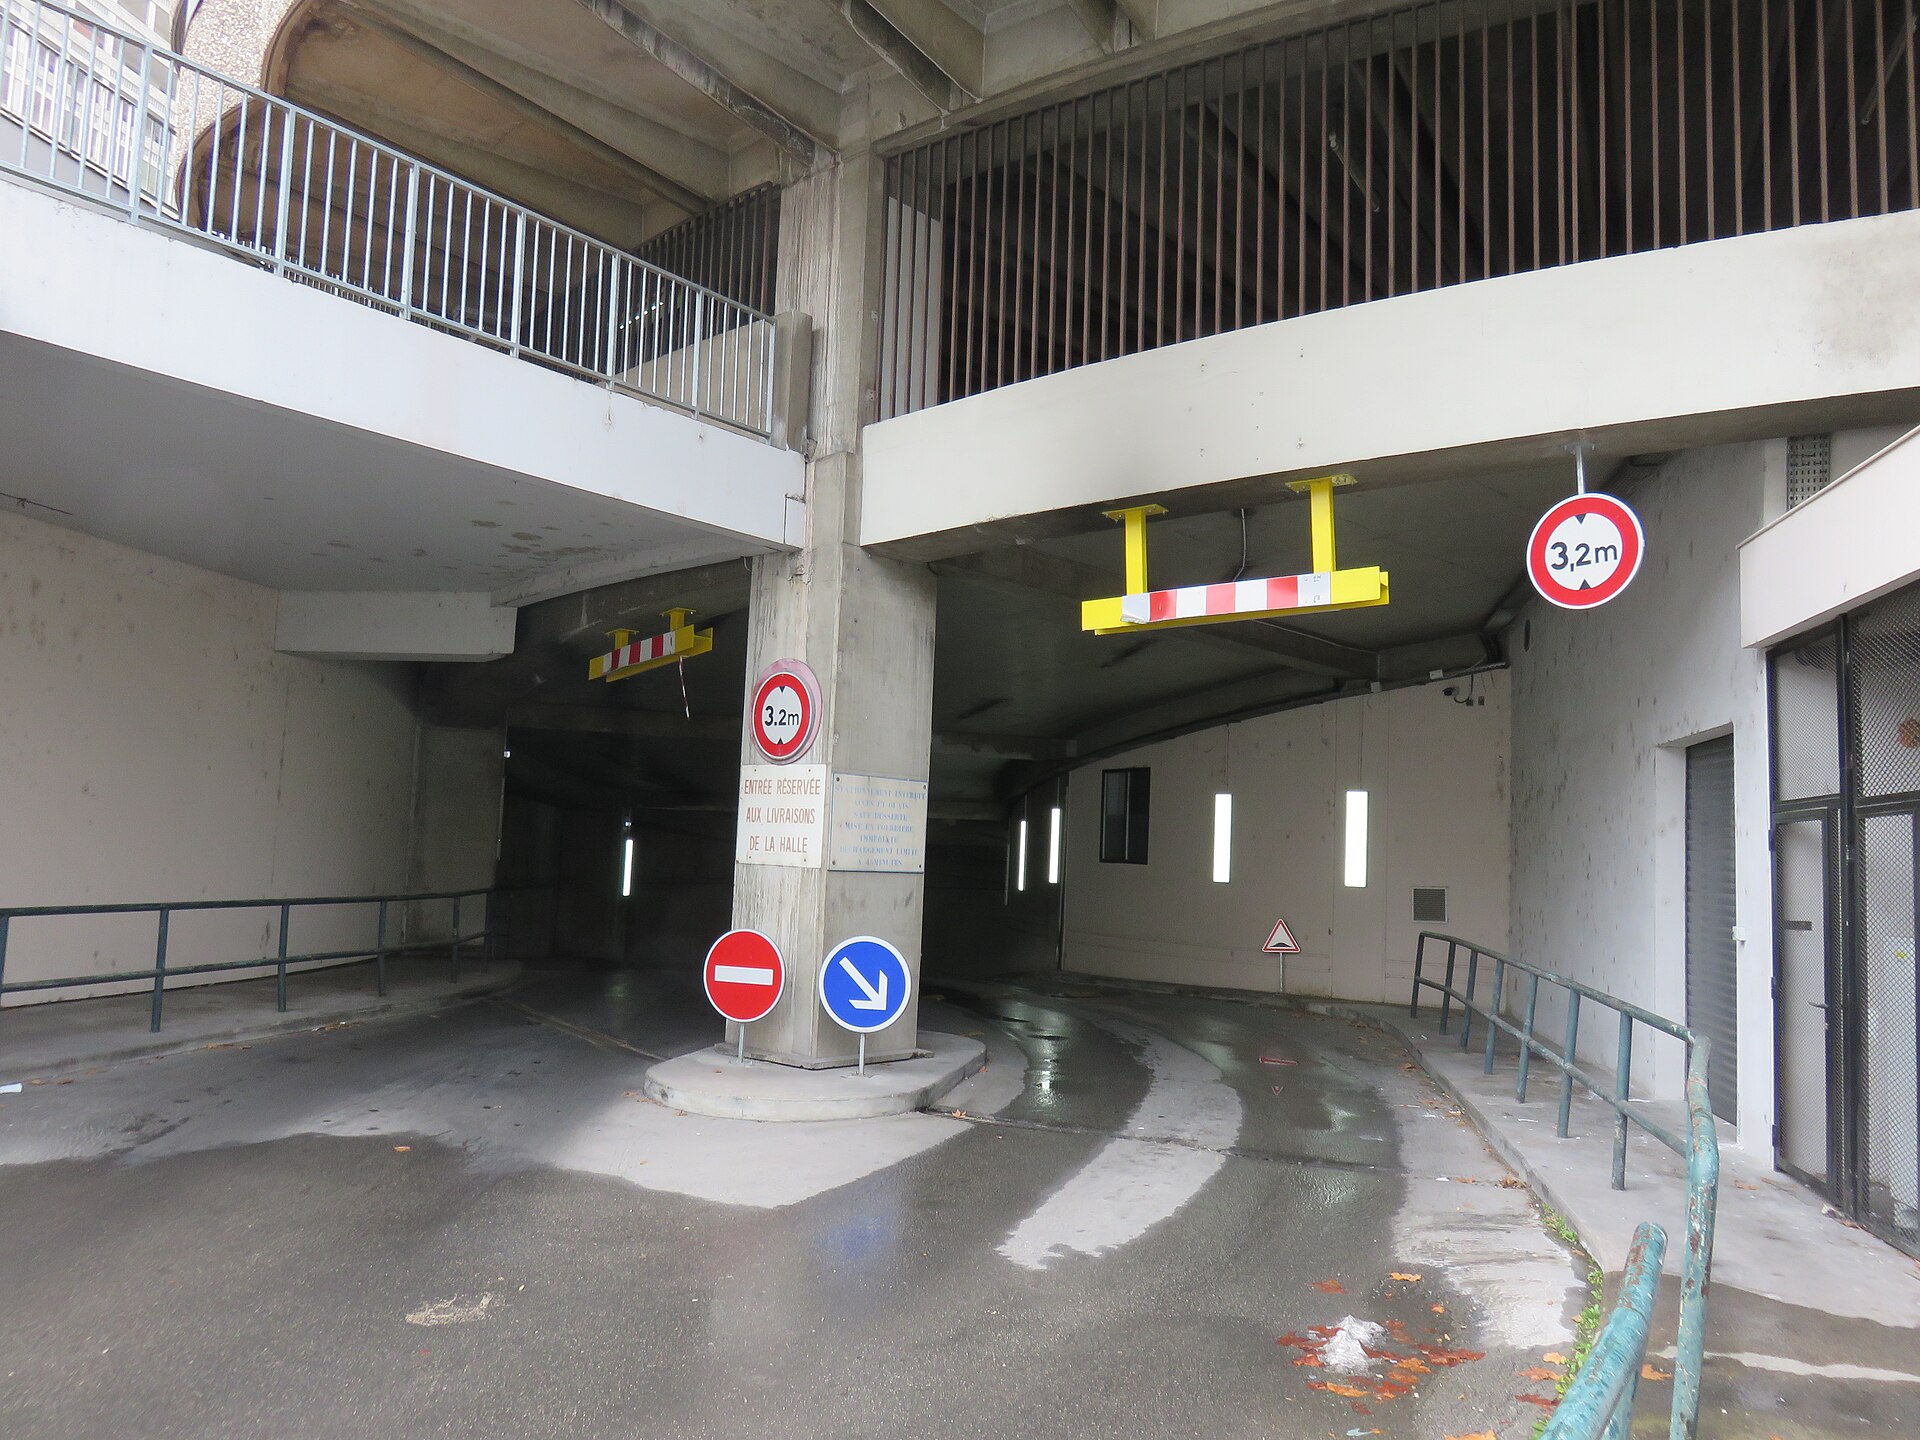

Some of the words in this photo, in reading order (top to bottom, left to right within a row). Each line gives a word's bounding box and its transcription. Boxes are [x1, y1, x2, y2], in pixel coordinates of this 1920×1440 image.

[1550, 542, 1618, 572] 3,2m
[764, 705, 799, 727] 3.2m
[744, 778, 772, 795] ENTRÉE
[776, 777, 821, 795] RÉSERVÉE
[745, 807, 762, 823] AUX
[766, 807, 815, 824] LIVRAISONS
[749, 835, 760, 851] DE
[764, 836, 775, 852] LA
[779, 836, 808, 853] HALLE
